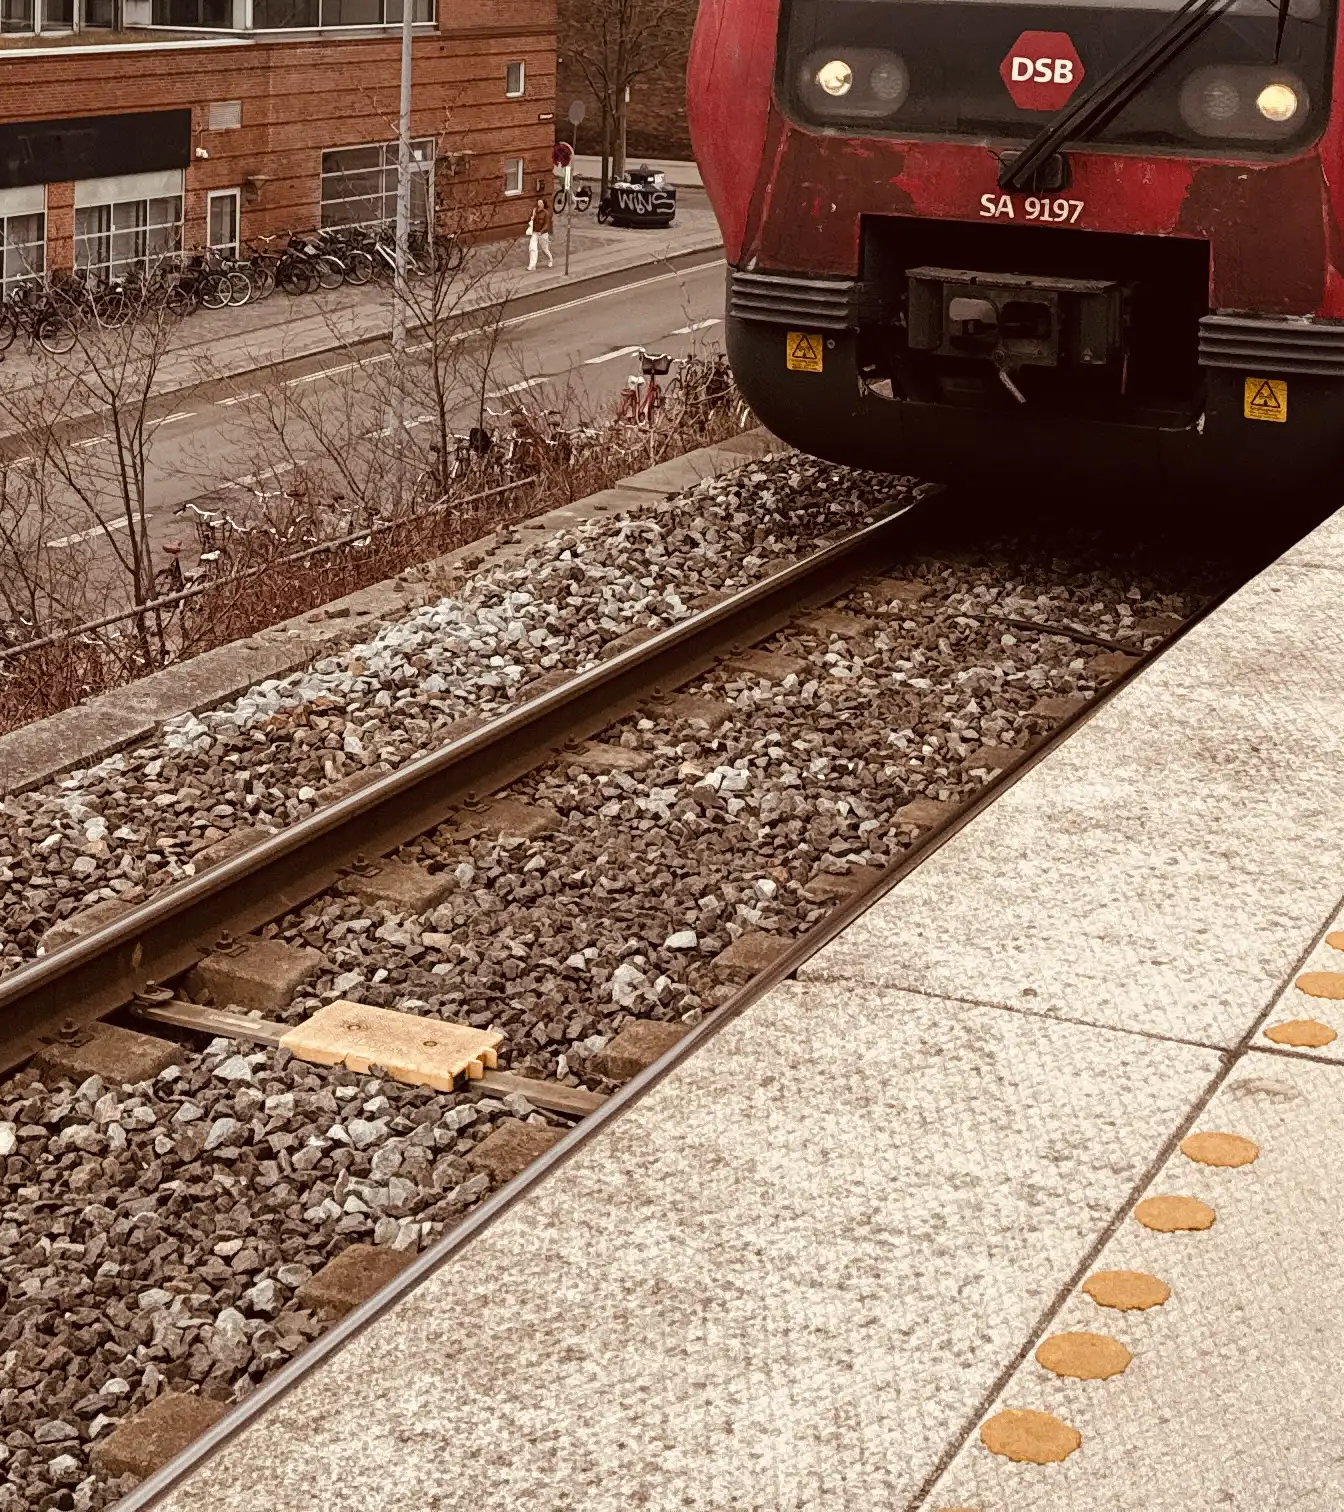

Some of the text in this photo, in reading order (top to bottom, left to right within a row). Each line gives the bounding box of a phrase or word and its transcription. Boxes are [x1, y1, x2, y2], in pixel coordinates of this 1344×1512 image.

[1011, 56, 1074, 84] DSB
[979, 193, 1085, 224] SA 9197
